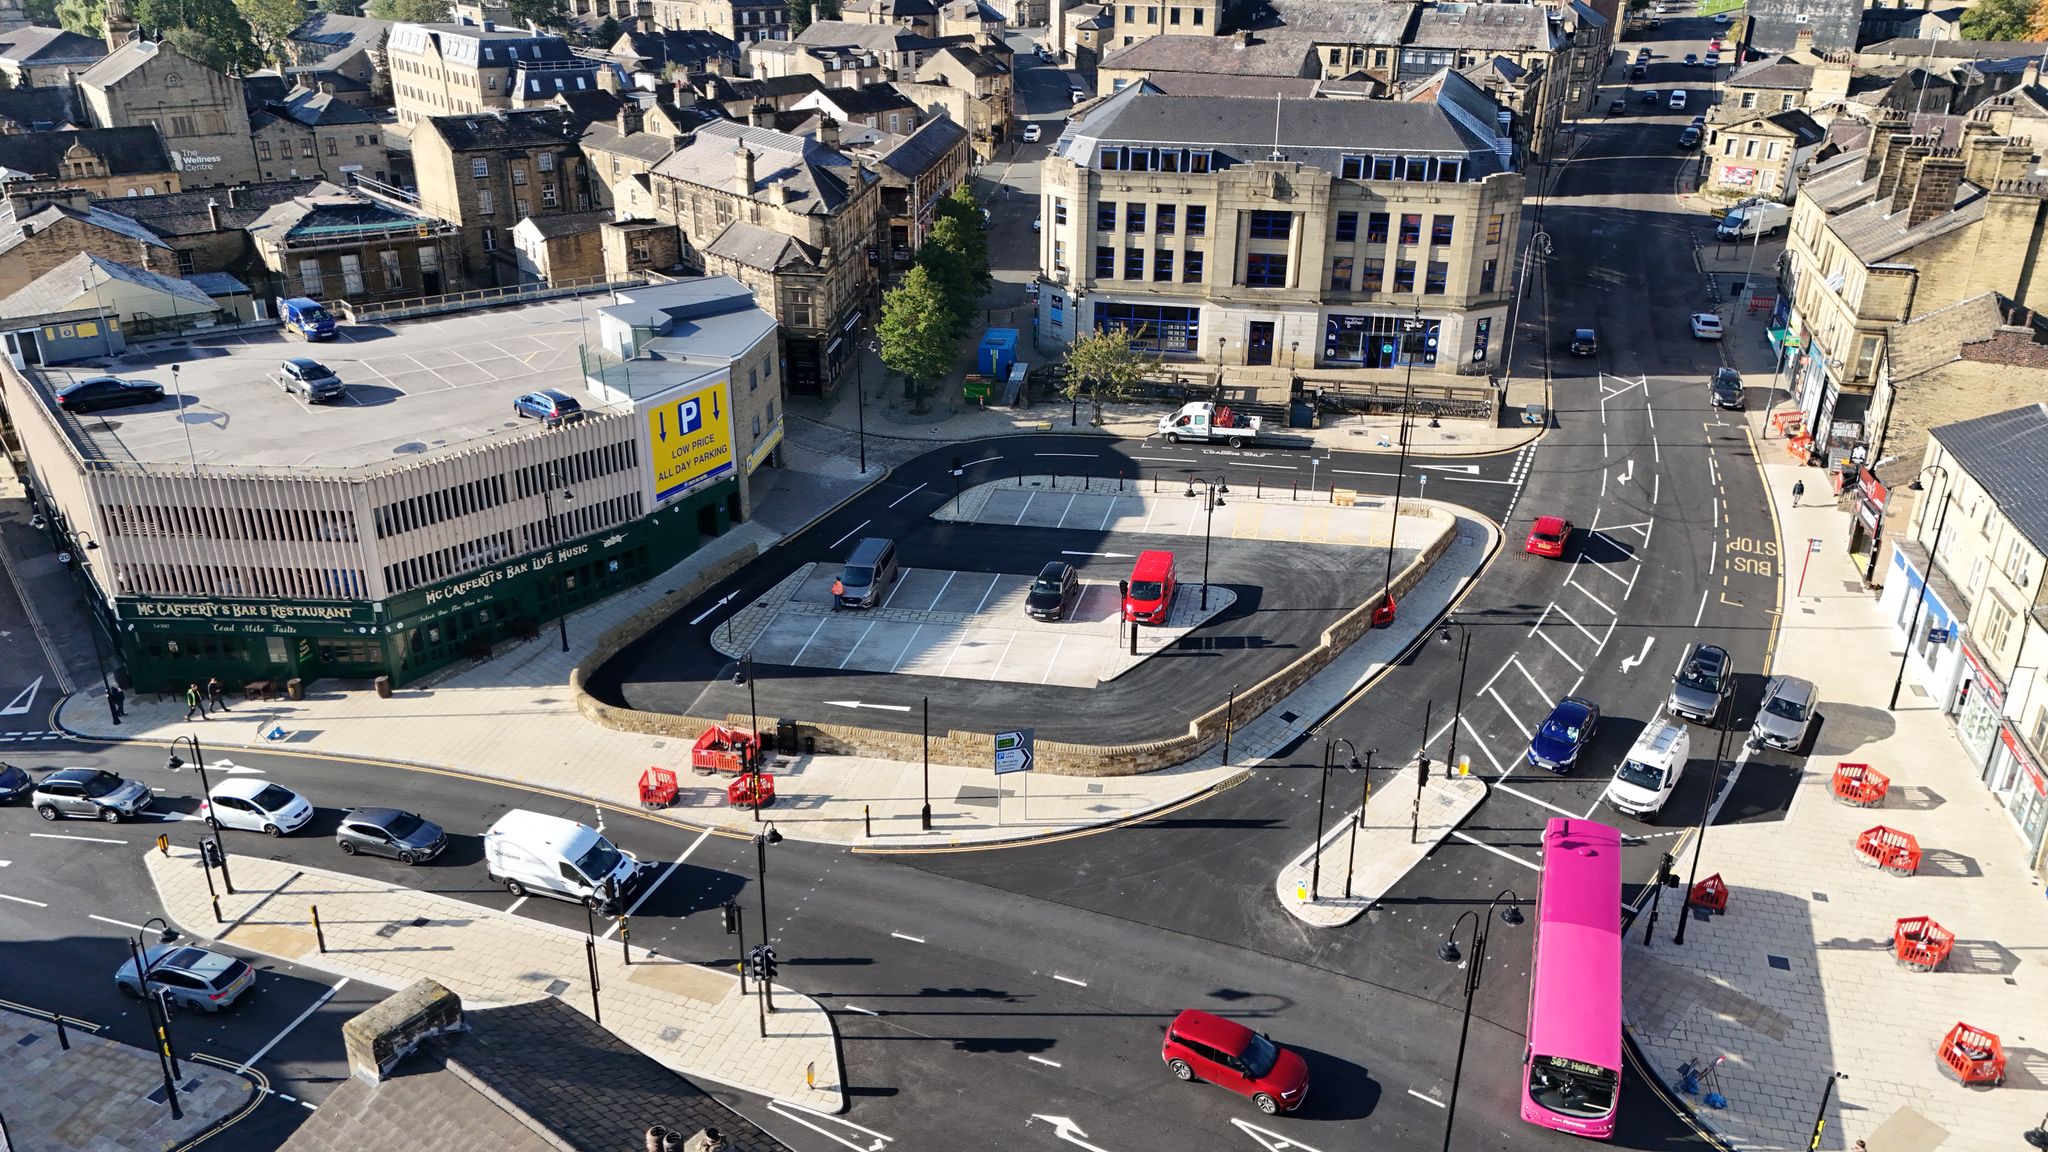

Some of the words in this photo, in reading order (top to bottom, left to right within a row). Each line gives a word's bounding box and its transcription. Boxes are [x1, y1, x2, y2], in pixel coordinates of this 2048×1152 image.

[182, 149, 198, 157] The
[183, 156, 221, 164] Wellness
[680, 400, 698, 434] P
[671, 443, 690, 459] LOW
[692, 433, 715, 449] PRICE
[658, 470, 674, 482] ALL
[675, 459, 692, 475] DAY
[693, 444, 728, 467] PARKING
[1729, 536, 1777, 556] STOP
[506, 563, 529, 579] BAR
[532, 551, 554, 570] LIVE
[558, 544, 589, 563] MUSIC
[1733, 557, 1771, 577] BUS
[270, 604, 353, 619] RESTAURANT
[1550, 1056, 1569, 1068] 587
[1571, 1061, 1600, 1076] Halifax
